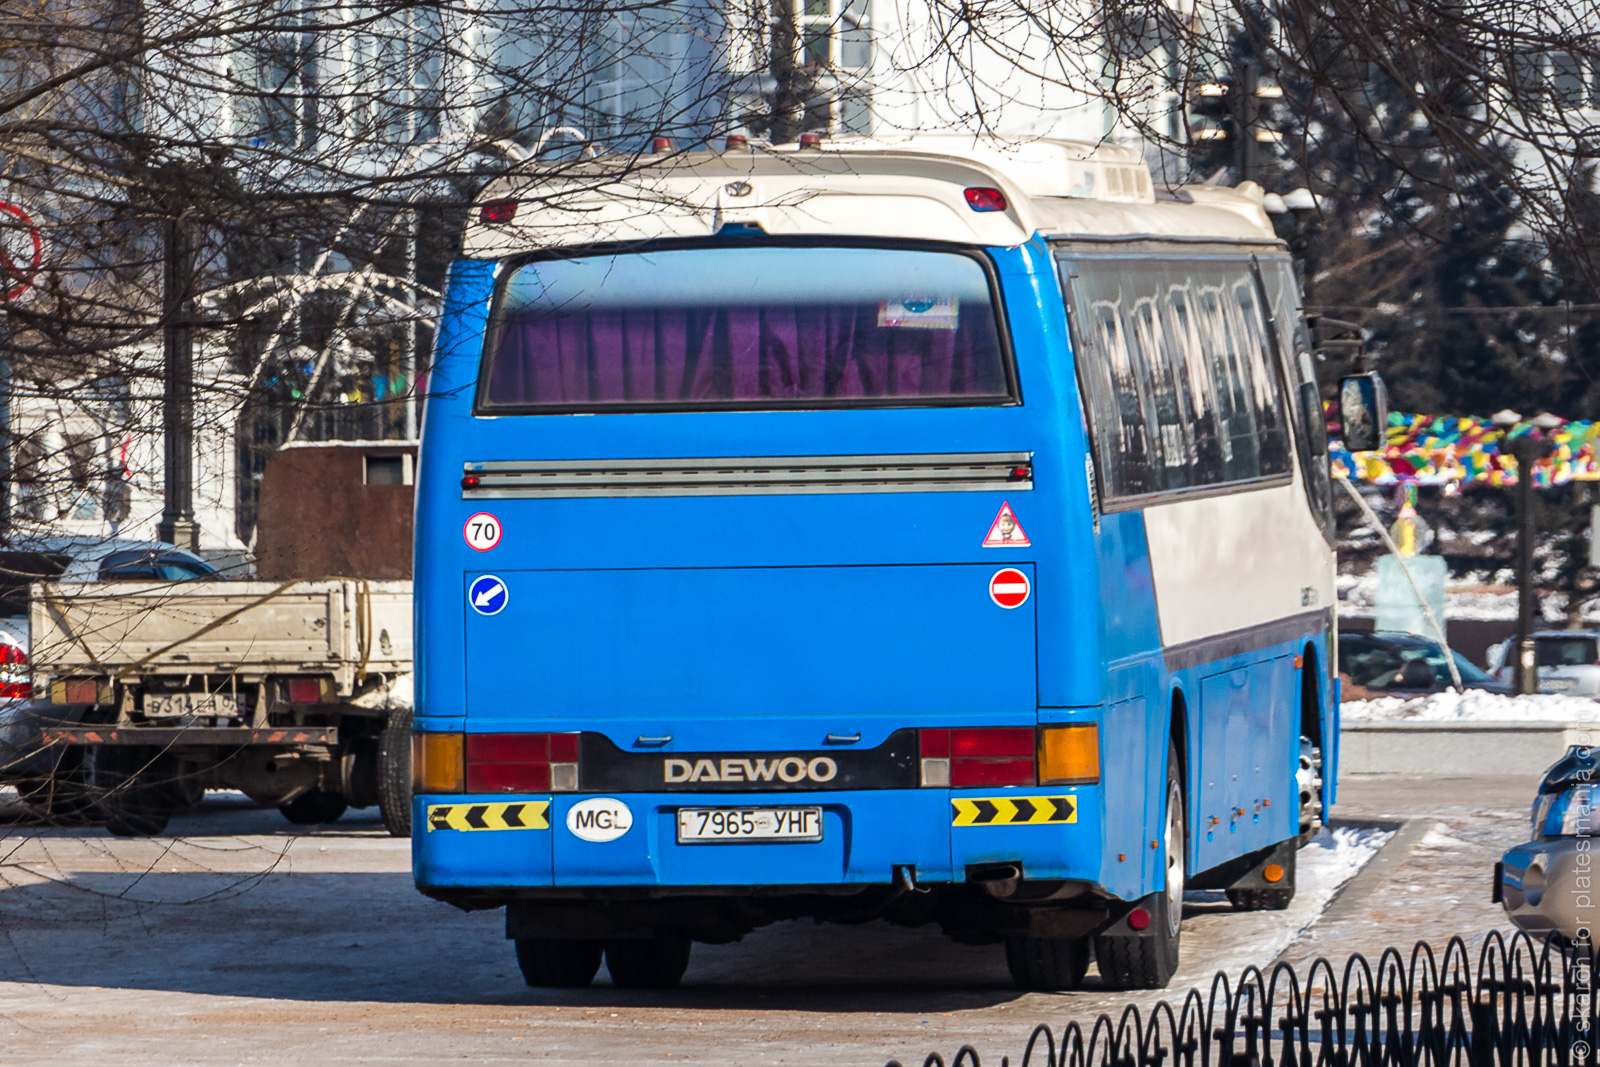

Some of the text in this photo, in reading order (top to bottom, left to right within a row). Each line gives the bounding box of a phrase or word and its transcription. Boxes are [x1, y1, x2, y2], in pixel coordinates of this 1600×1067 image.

[471, 523, 495, 541] 70
[664, 757, 838, 782] DAEWOO
[576, 810, 627, 830] MGL
[697, 811, 755, 835] 7965
[774, 811, 817, 833] УНГ
